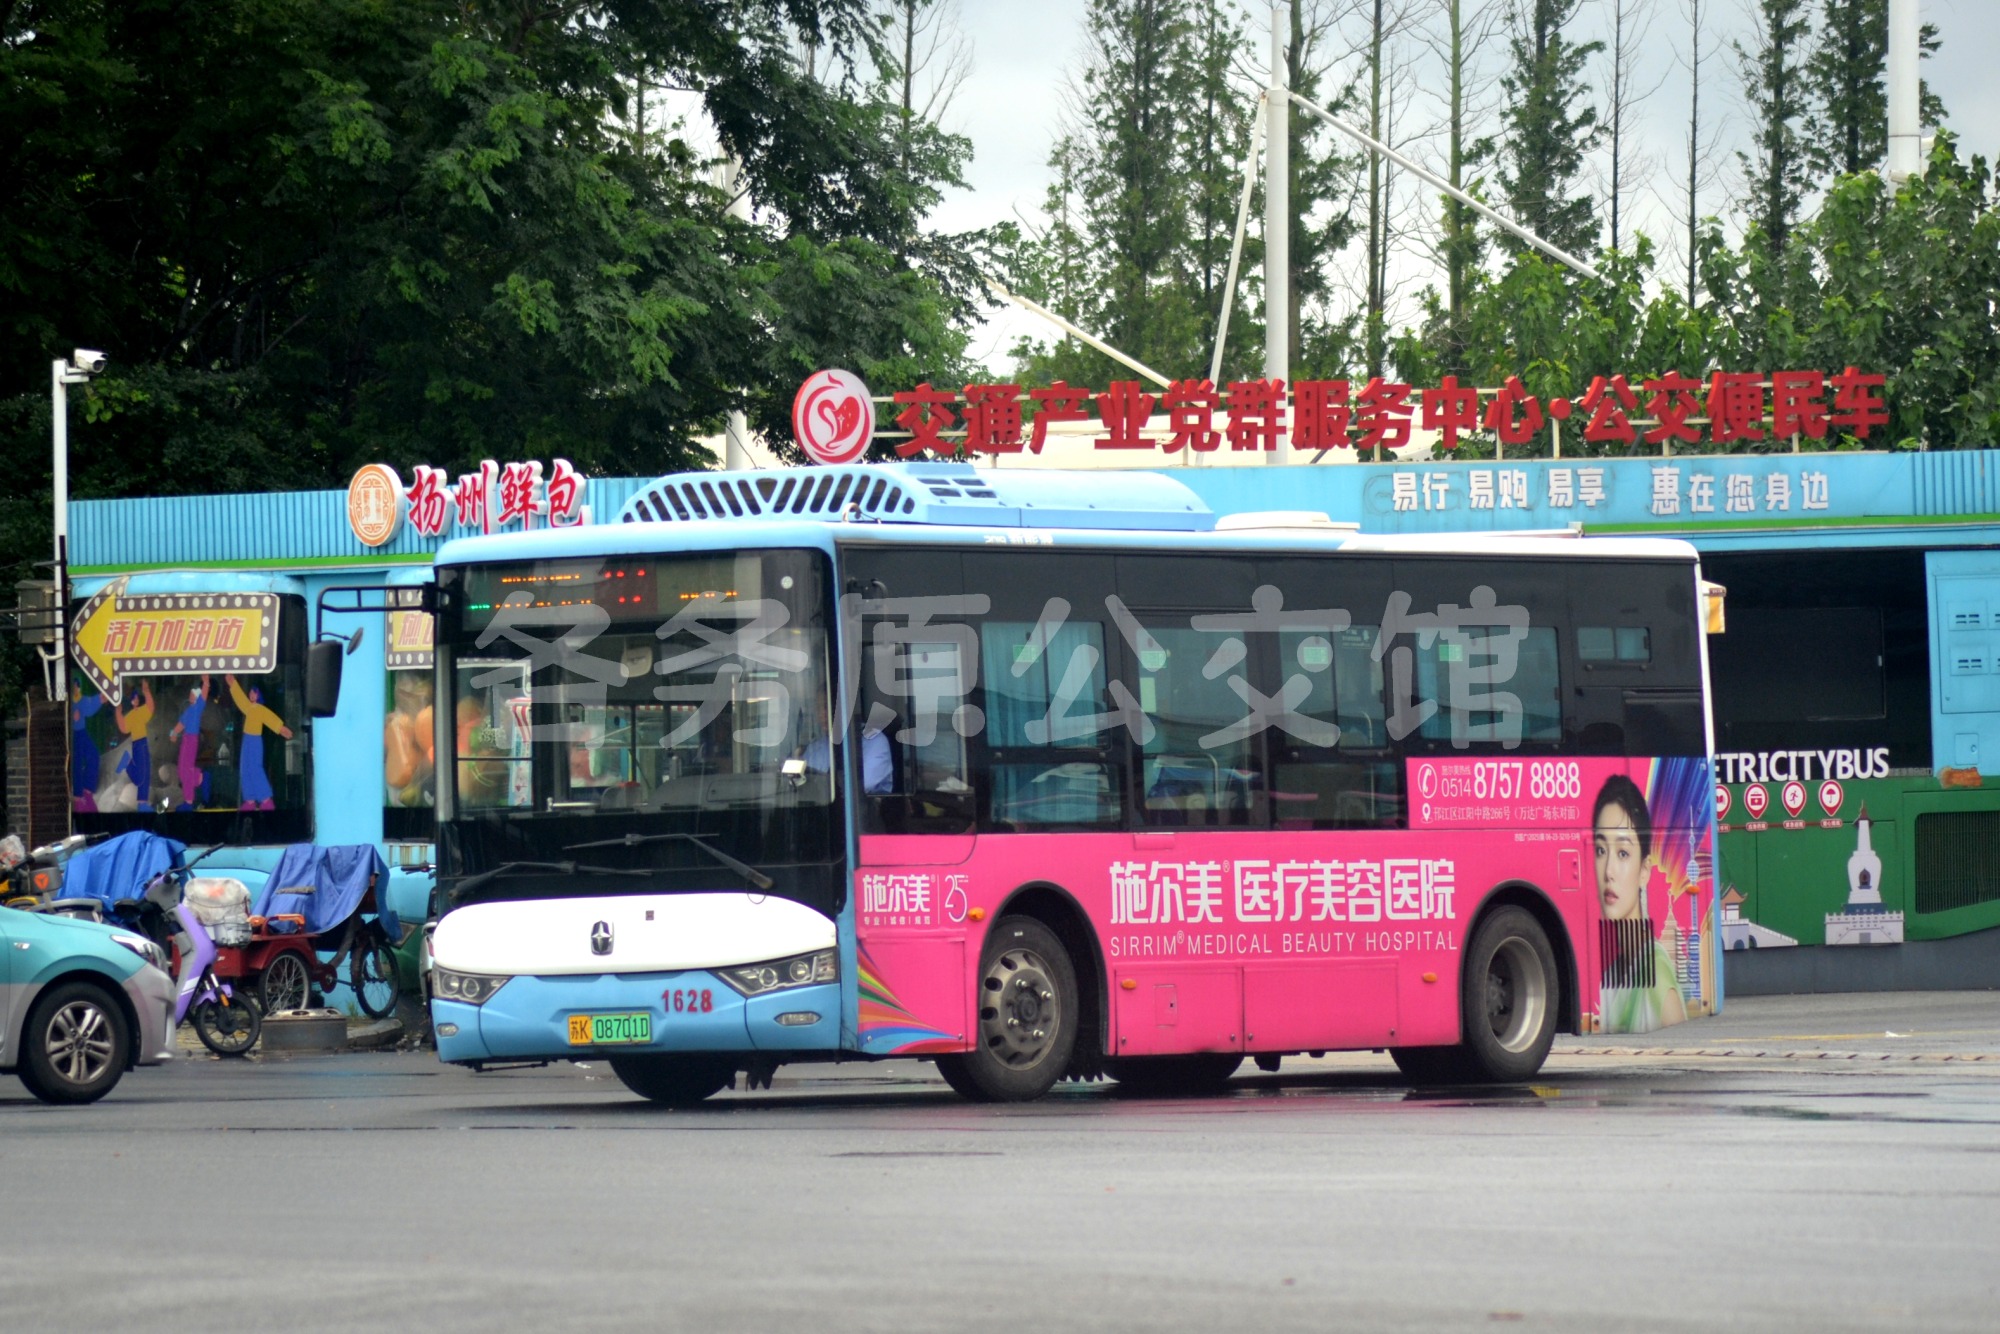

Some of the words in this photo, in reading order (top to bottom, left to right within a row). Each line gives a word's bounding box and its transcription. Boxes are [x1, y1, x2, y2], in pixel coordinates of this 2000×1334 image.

[893, 366, 1890, 456] 交通产业党群服务中心·公交便民车
[405, 458, 592, 537] 扬州鲜包
[1651, 466, 1830, 516] 惠在您身边
[103, 617, 246, 655] 活力加油站
[1441, 778, 1472, 798] 0514
[1474, 762, 1523, 799] 8757
[1530, 761, 1581, 798] 8888
[944, 874, 968, 923] 25
[1234, 858, 1456, 923] 医疗美容医院
[1188, 933, 1273, 955] MEDICAL
[1282, 932, 1356, 953] BEAUTY
[1366, 930, 1457, 951] HOSPITAL
[661, 988, 714, 1014] 1628
